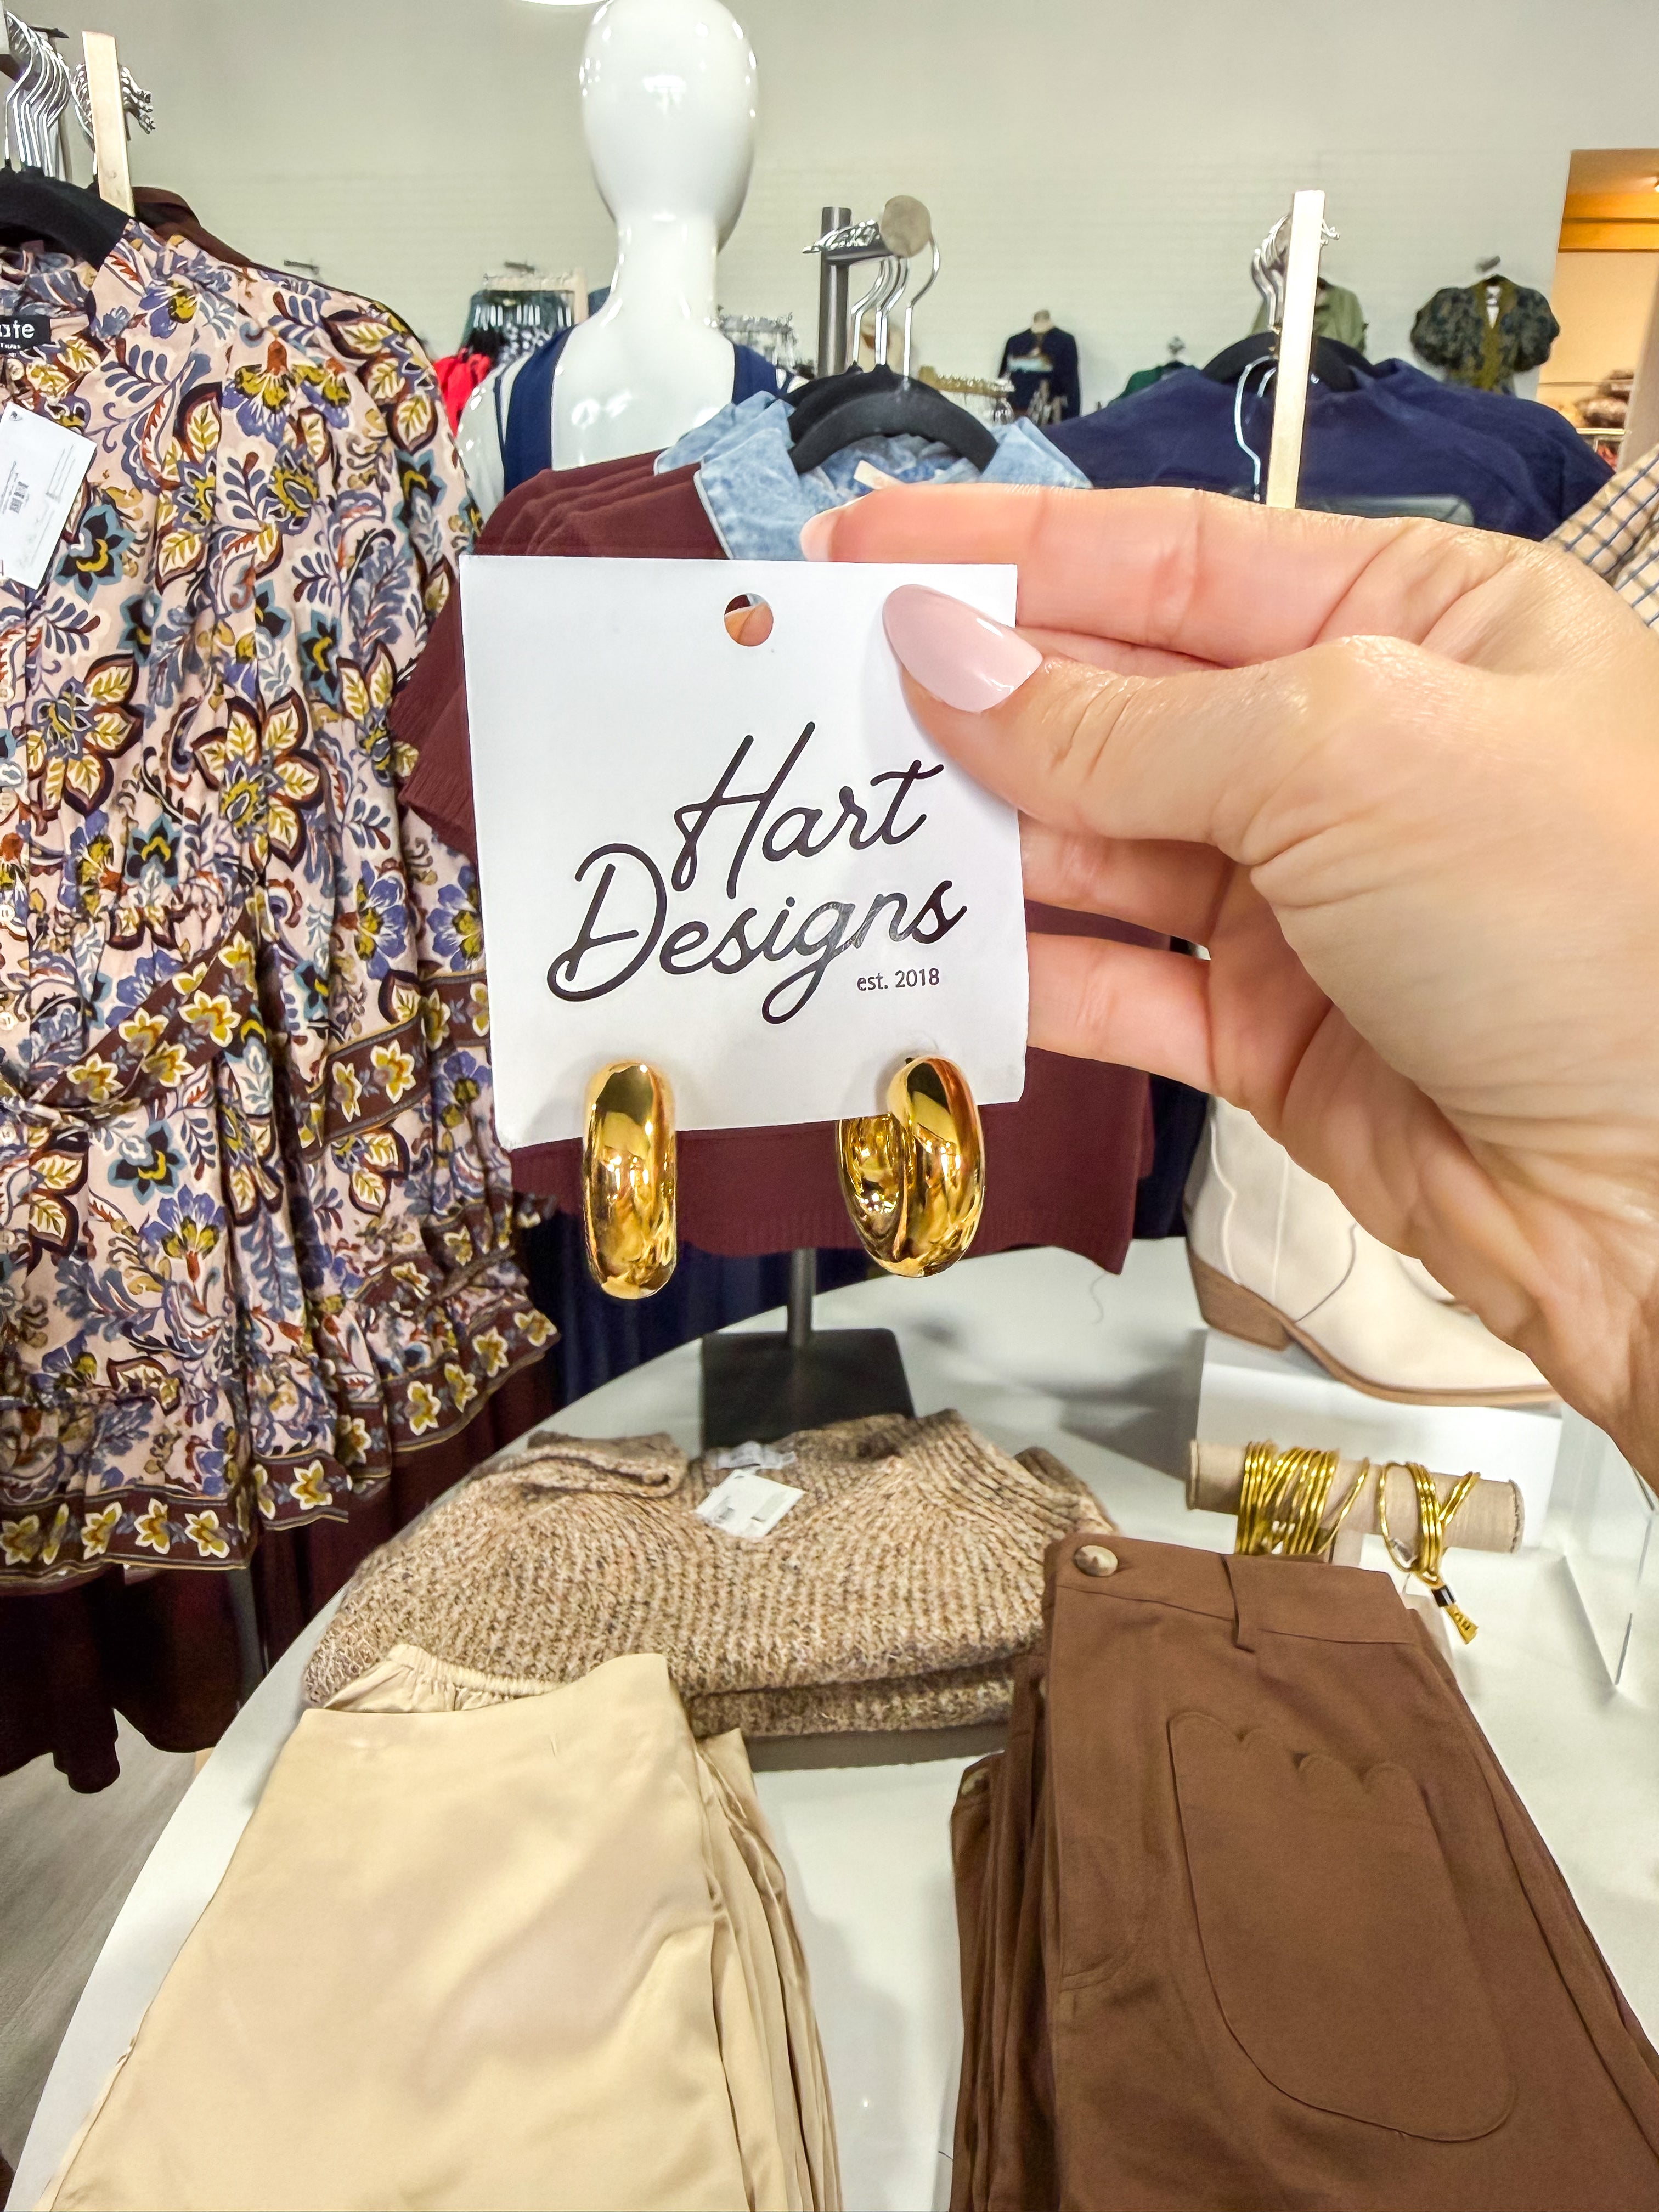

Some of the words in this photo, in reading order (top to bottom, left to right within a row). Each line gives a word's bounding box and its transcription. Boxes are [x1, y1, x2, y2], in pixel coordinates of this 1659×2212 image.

[674, 721, 945, 900] Hart
[546, 843, 968, 1025] Designs
[856, 972, 889, 991] est.
[895, 967, 940, 988] 2018
